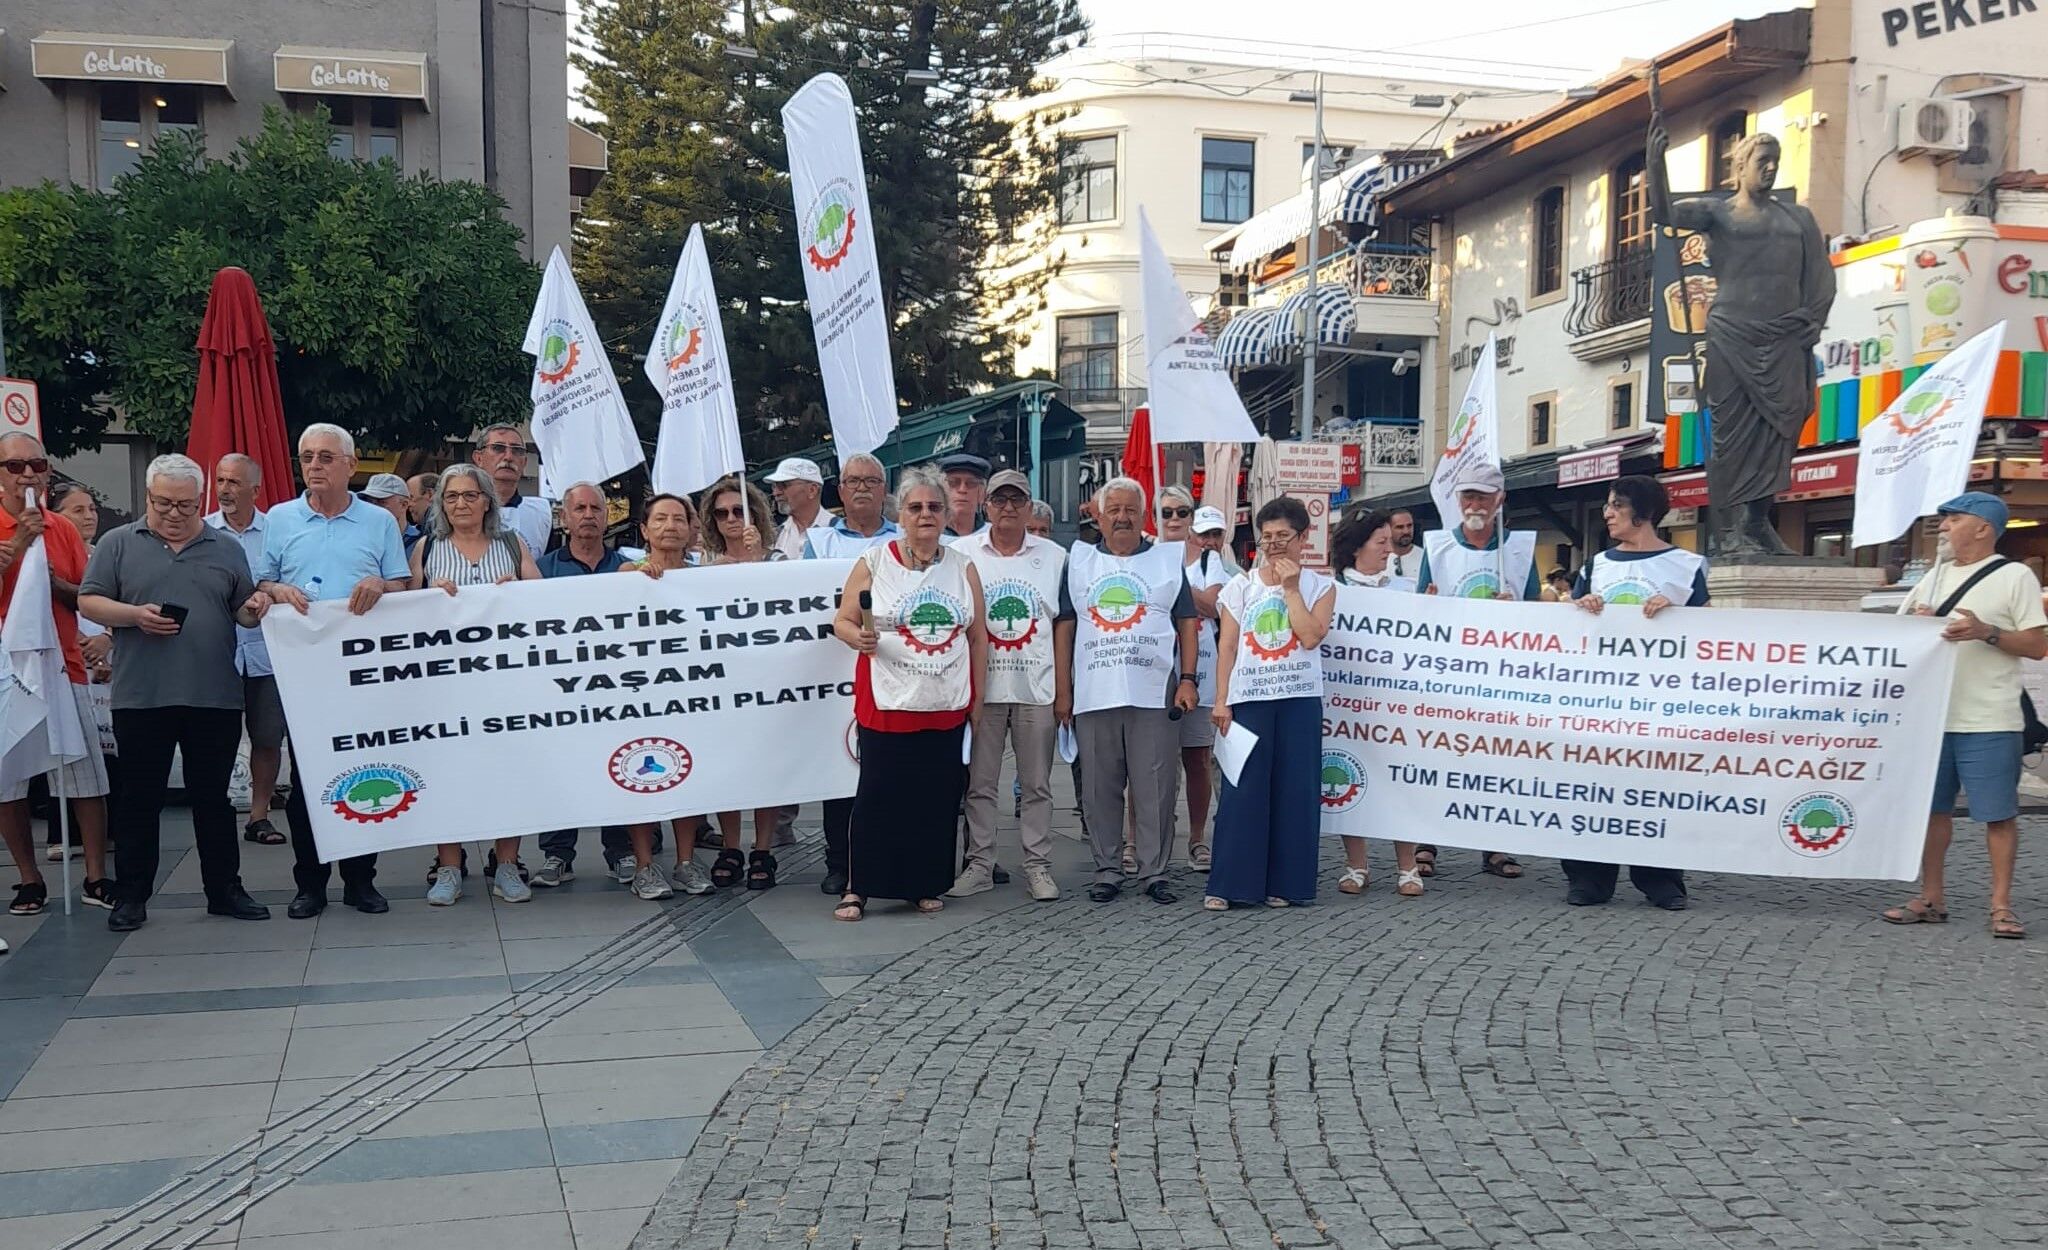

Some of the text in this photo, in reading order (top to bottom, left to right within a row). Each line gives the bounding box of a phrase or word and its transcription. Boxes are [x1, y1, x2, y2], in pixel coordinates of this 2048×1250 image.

[342, 588, 844, 657] DEMOKRATİK TÜRKİ
[1084, 634, 1159, 651] TÜM EMEKLİLERİN
[1094, 646, 1140, 659] SENDİKASI
[1598, 635, 1687, 659] HAYDİ
[1696, 640, 1755, 662] SEN
[1766, 643, 1807, 664] DE
[1817, 645, 1908, 668] KATIL
[349, 638, 689, 686] EMEKLİLİKTE
[553, 662, 726, 693] YAŞAM
[1087, 656, 1154, 671] ANTALYA ŞUBESİ
[1237, 666, 1256, 677] TÜM
[1320, 643, 1905, 699] sanca yaşam haklarımız ve taleplerimiz ile
[1241, 682, 1315, 698] ANTALYA ŞUBESİ
[1252, 673, 1300, 687] SENDİKASI
[332, 681, 857, 752] EMEKLİ SENDİKALARI PLATFO
[1387, 702, 1407, 715] ve
[1414, 703, 1520, 726] demokratik
[1526, 713, 1552, 728] bir
[1559, 714, 1649, 736] TÜRKİYE
[1657, 724, 1775, 744] mücadelesi
[1782, 732, 1883, 751] veriyoruz.
[1558, 695, 1623, 710] onurlu
[1629, 696, 1657, 711] bir
[1662, 700, 1741, 716] gelecek
[1749, 703, 1845, 723] bırakmak
[1852, 709, 1888, 727] için
[1321, 718, 1408, 746] SANCA
[1416, 728, 1555, 761] YAŞAMAK
[1387, 764, 1438, 787] TÜM
[1445, 772, 1615, 804] EMEKLİLERİN
[1623, 787, 1766, 816] SENDİKASI
[1444, 802, 1666, 839] ANTALYA ŞUBESİ
